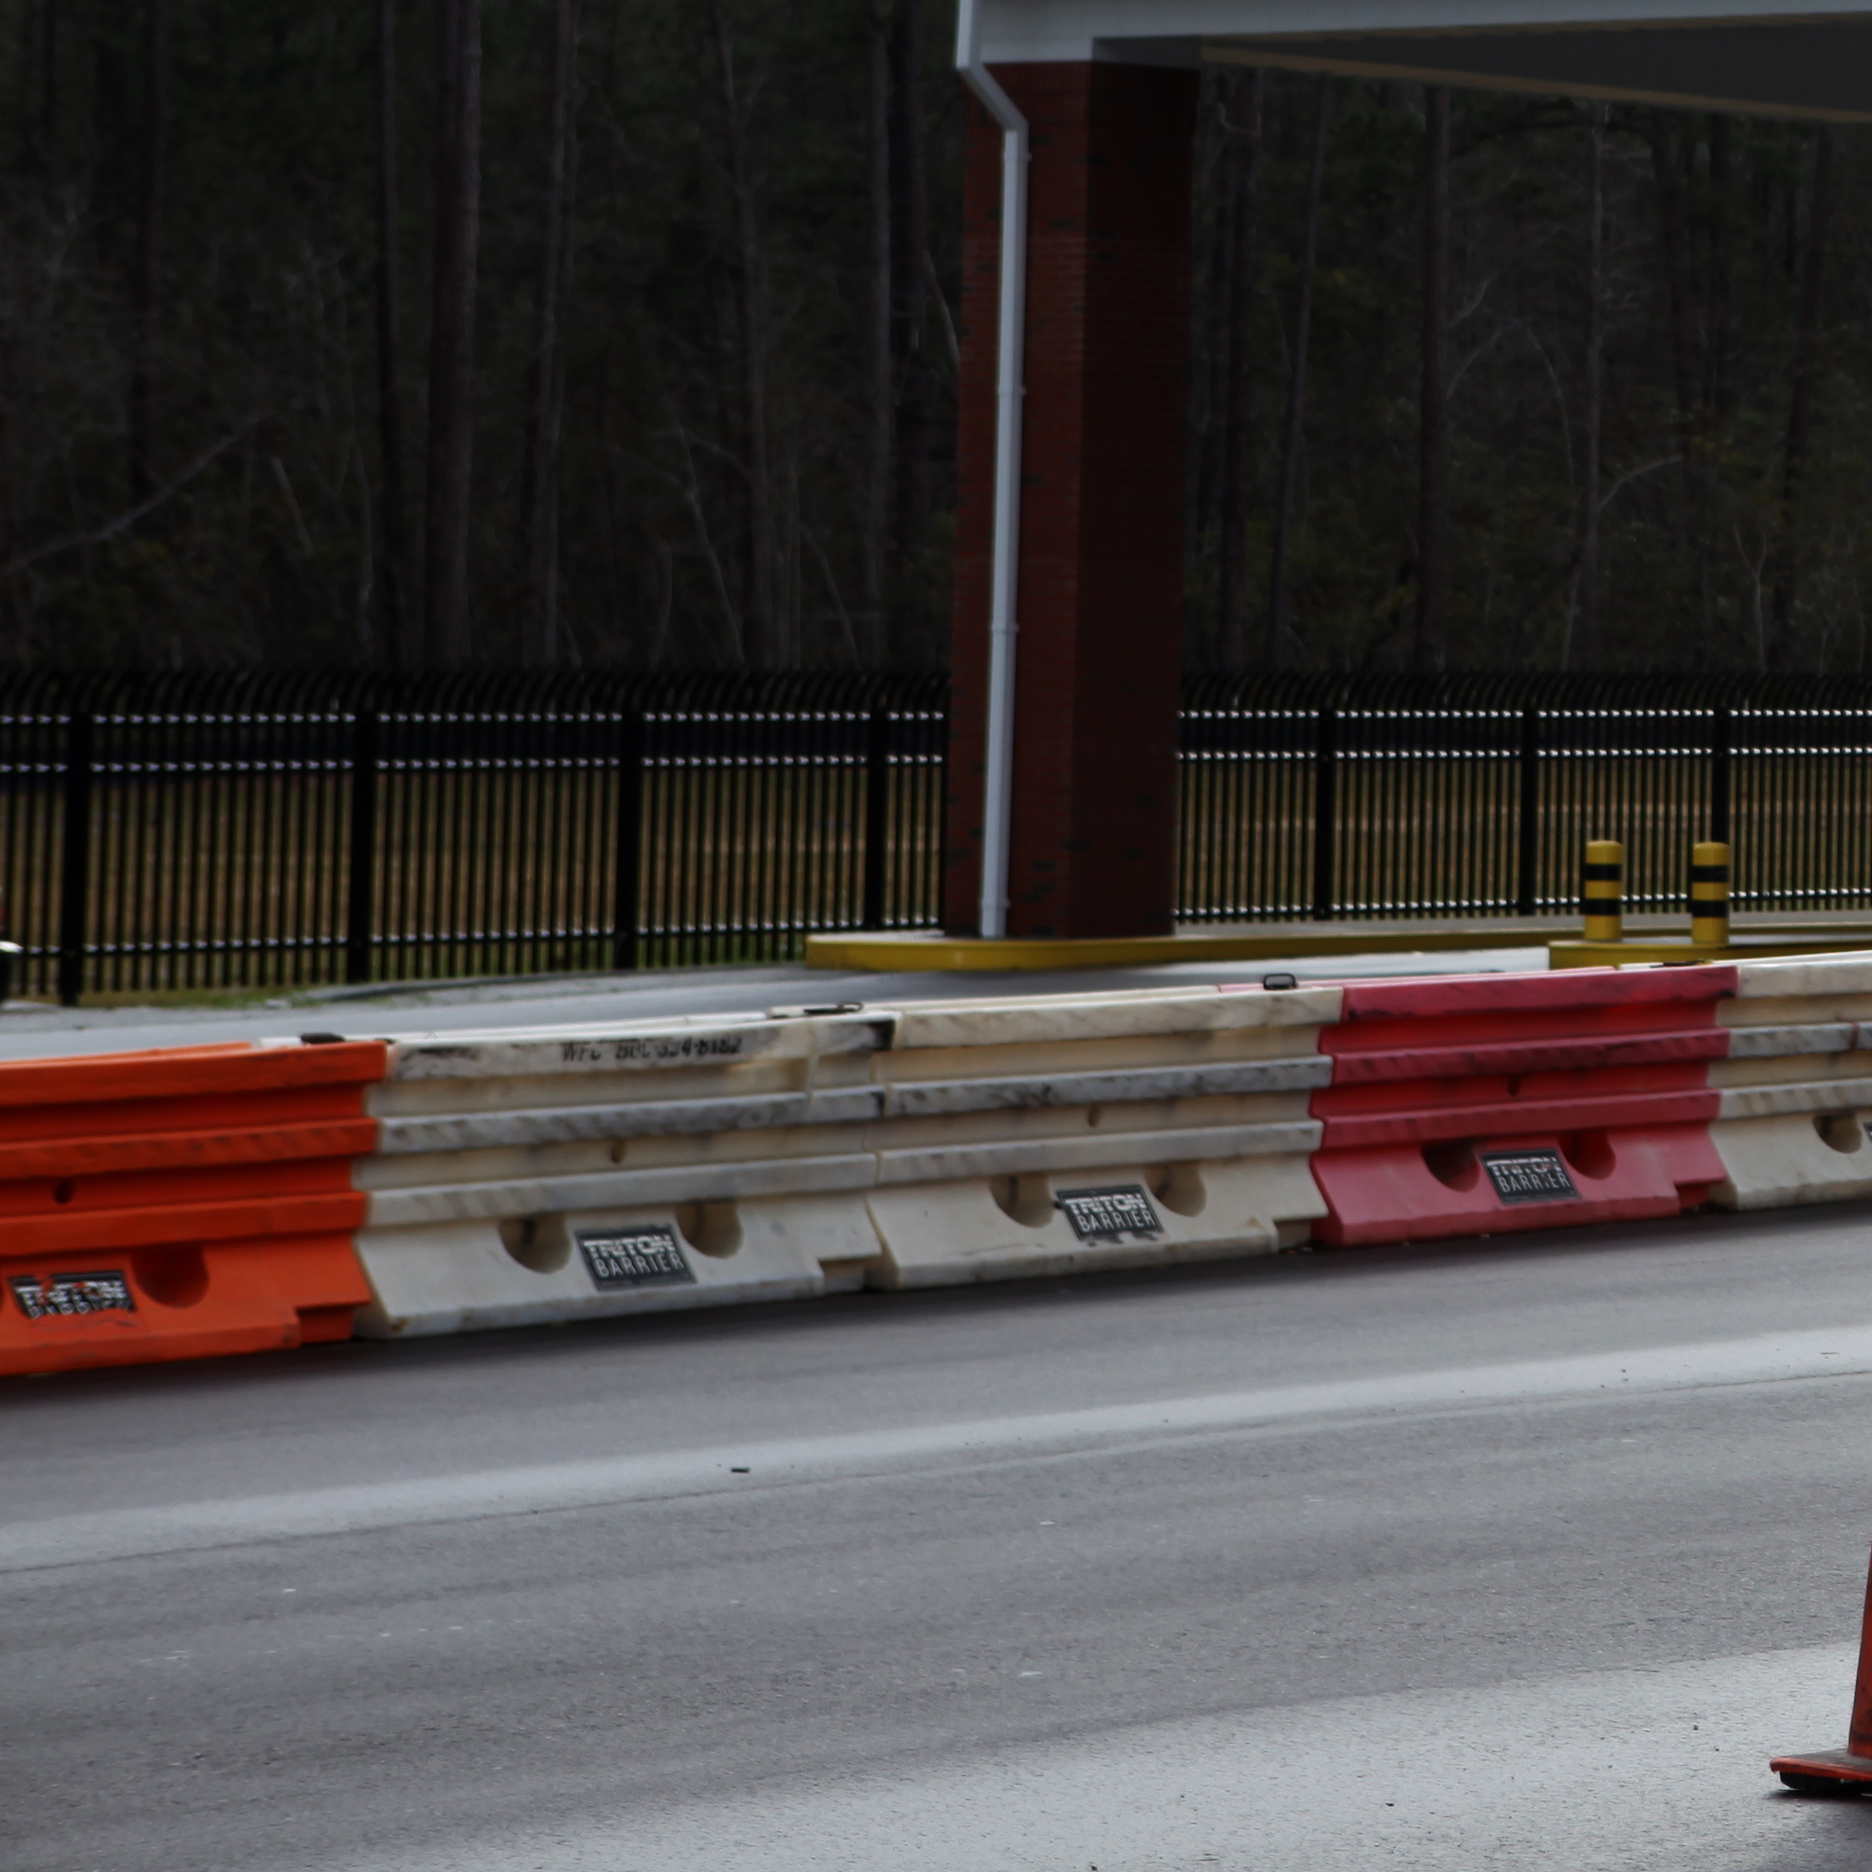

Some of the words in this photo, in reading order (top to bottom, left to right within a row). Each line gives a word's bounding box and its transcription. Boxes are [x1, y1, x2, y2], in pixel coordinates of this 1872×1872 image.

[1498, 1172, 1571, 1193] BARRIER
[1064, 1192, 1148, 1215] TRITON
[1077, 1209, 1157, 1233] BARRIER
[583, 1234, 677, 1259] TRITON
[596, 1251, 685, 1278] BARRIER
